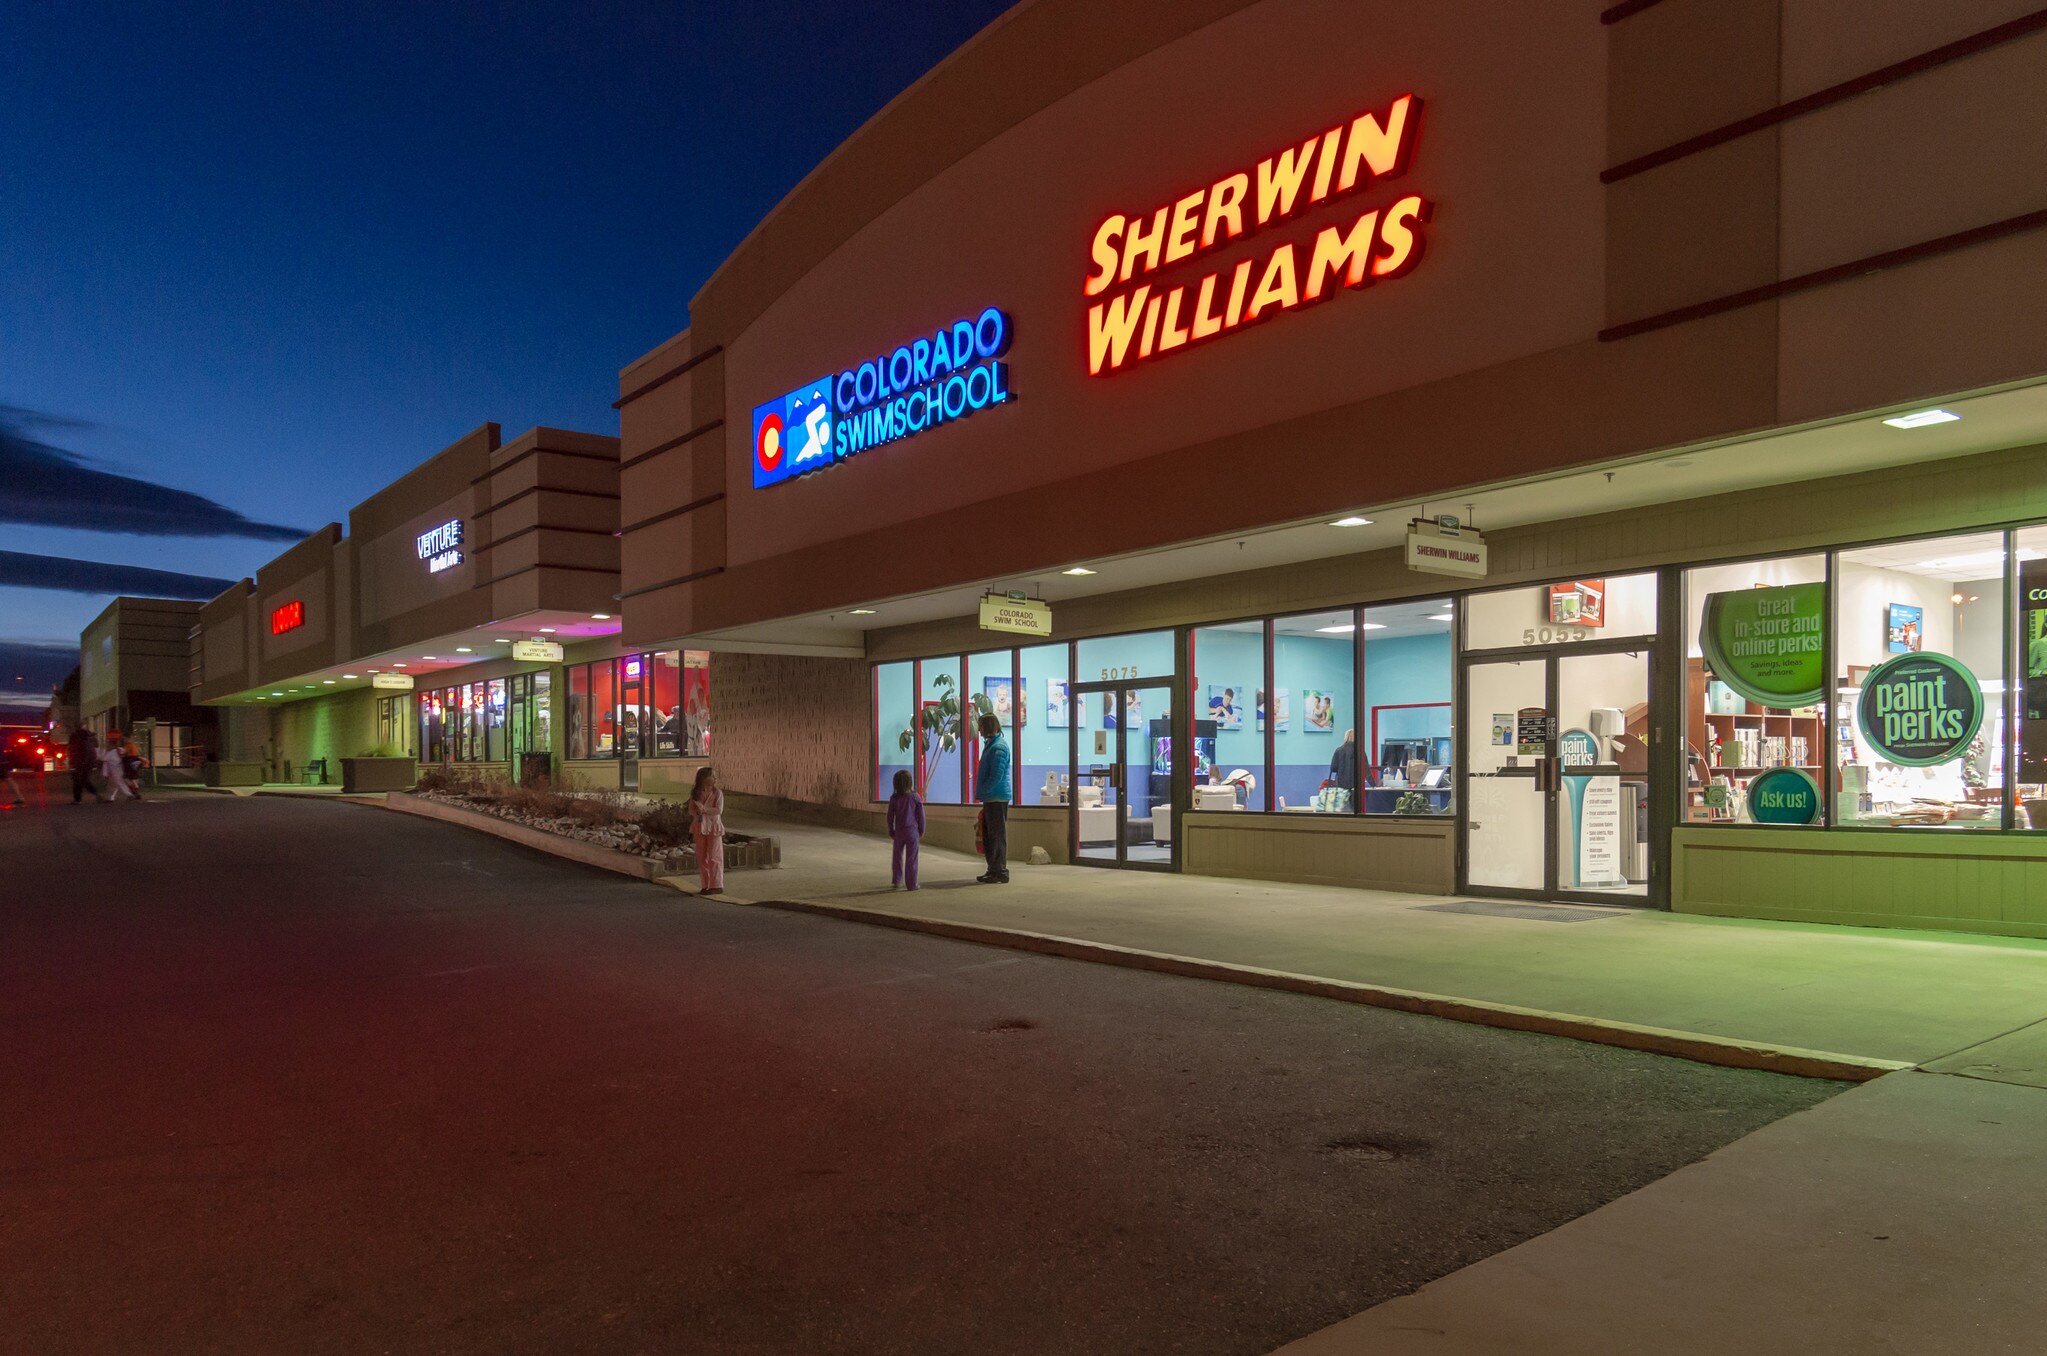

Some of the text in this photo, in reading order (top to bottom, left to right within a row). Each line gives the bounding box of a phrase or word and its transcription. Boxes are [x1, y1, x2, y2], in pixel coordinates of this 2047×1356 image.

[1084, 93, 1413, 296] SHERWIN
[1088, 196, 1422, 376] WILLIAMS
[836, 306, 1003, 413] COLORADO
[417, 519, 458, 559] VENTURE
[1417, 544, 1480, 564] SHERWIN WILLIAMS
[1000, 608, 1034, 620] COLORADO
[1758, 596, 1796, 616] Great
[993, 616, 1039, 629] SWIM SCHOOL
[1735, 613, 1820, 638] in-store and
[1522, 627, 1586, 646] 5055
[1732, 632, 1822, 657] online perks!
[1101, 665, 1138, 681] 5075
[1750, 659, 1803, 670] Savings, ideas
[1876, 675, 1947, 718] paint
[1884, 706, 1963, 747] perks
[1561, 737, 1589, 757] paint
[1760, 790, 1807, 808] Ask us!
